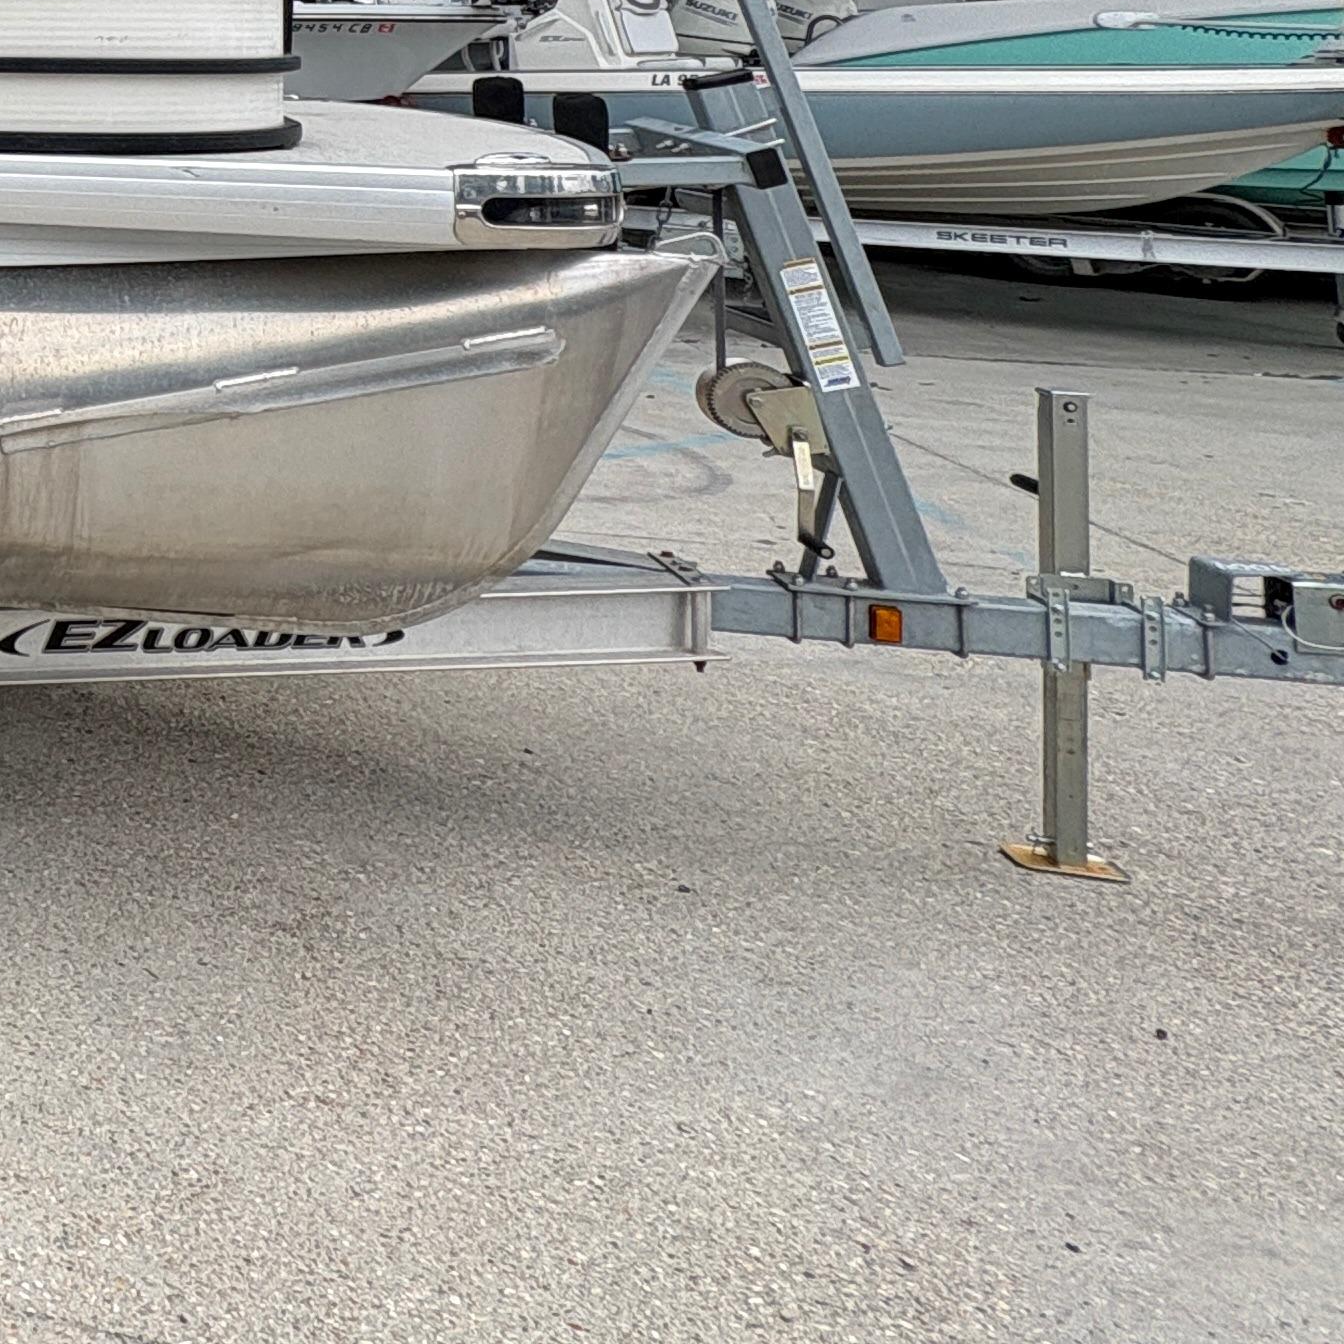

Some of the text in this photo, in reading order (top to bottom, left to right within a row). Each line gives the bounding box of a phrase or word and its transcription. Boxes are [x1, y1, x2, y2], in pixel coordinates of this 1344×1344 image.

[776, 2, 813, 20] UZUKI
[651, 74, 671, 87] LA
[936, 230, 1068, 249] SKEETER
